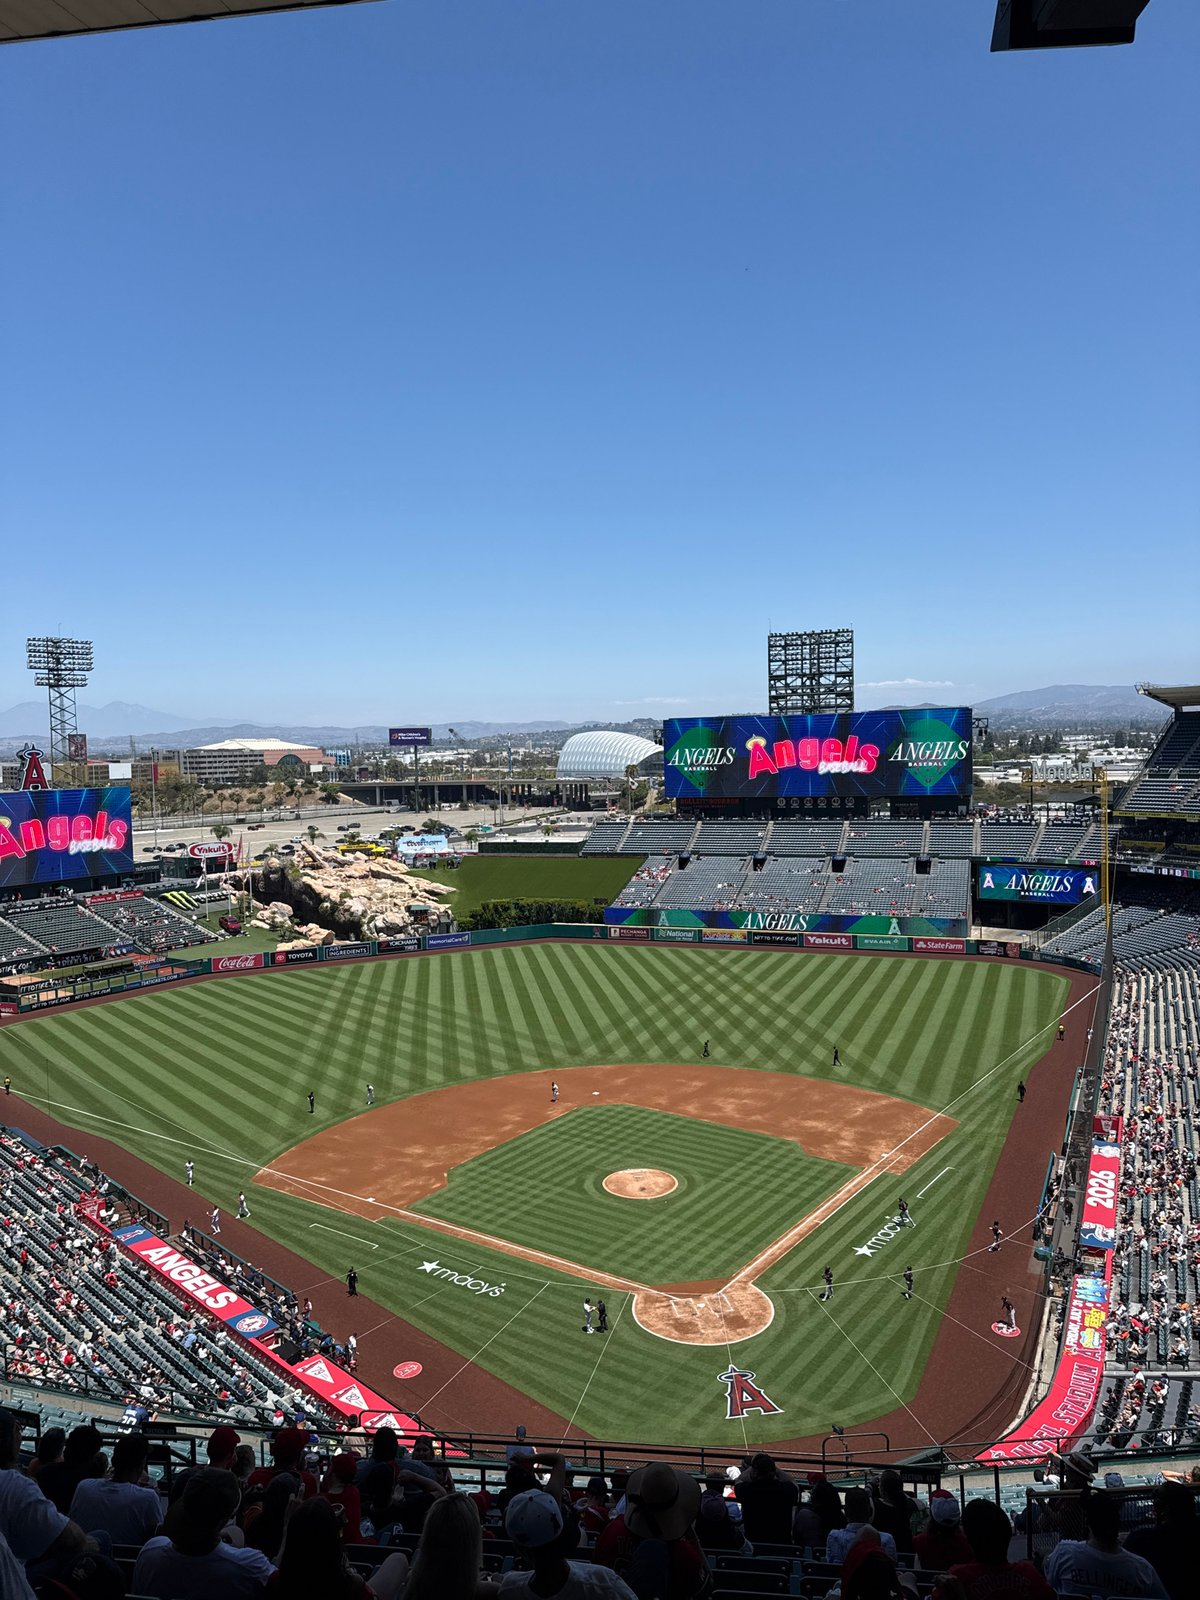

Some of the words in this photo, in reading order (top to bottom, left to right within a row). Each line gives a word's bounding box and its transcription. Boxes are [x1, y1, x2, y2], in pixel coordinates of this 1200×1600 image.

[667, 746, 737, 766] ANGELS
[749, 735, 880, 780] Angels
[888, 740, 970, 762] ANGELS
[818, 758, 868, 775] BASEBALL
[1032, 761, 1093, 781] Modelo
[197, 843, 227, 854] Yakult
[1004, 874, 1074, 893] ANGELS
[740, 913, 809, 931] ANGELS
[388, 939, 418, 947] YOKOHAMA
[429, 937, 462, 945] MemorialCare
[666, 930, 694, 938] National
[807, 936, 849, 945] Yakult
[288, 952, 313, 960] TOYOTA
[329, 948, 367, 956] INGREDIENTS
[1086, 1170, 1116, 1209] 2026
[140, 1245, 238, 1309] ANGELS
[1052, 1361, 1099, 1426] STADIUM
